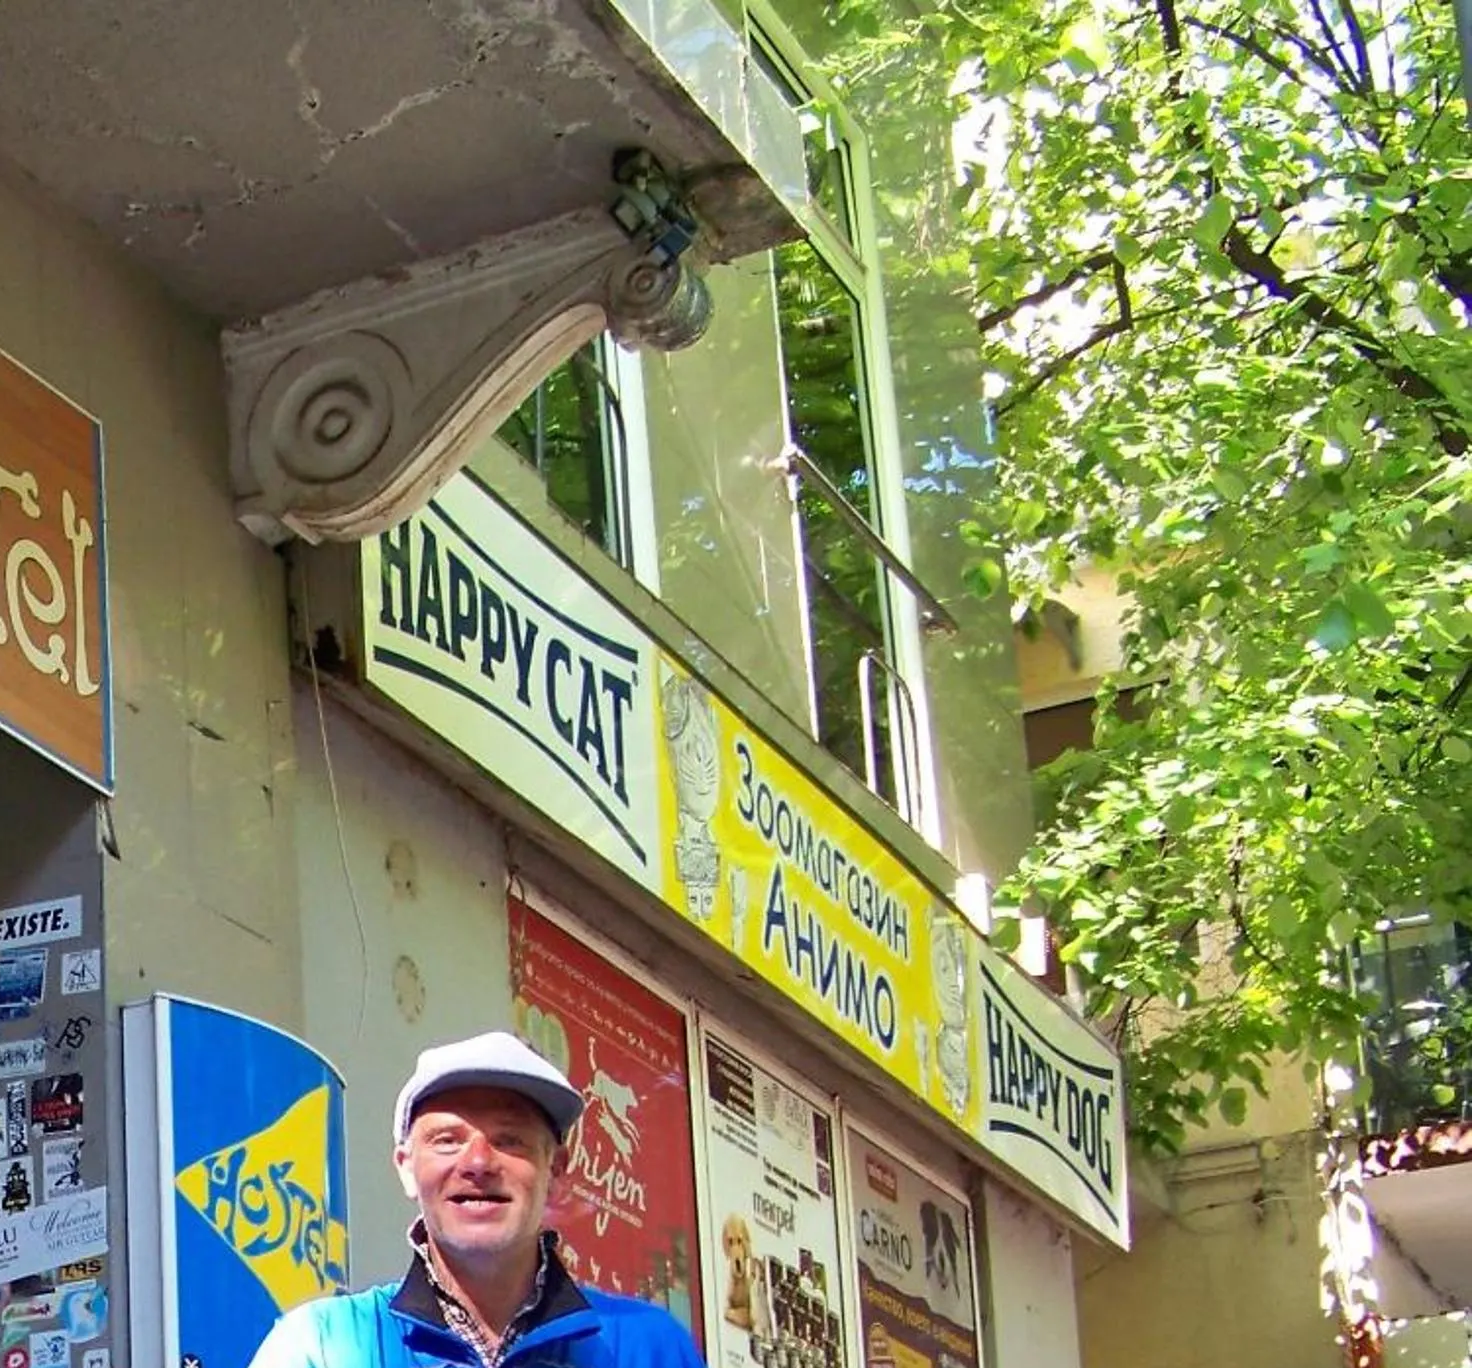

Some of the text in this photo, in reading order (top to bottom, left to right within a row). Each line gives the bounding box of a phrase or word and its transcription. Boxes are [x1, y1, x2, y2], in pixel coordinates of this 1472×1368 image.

[378, 518, 639, 805] HAPPY CAT
[984, 998, 1116, 1196] HAPPY DOG
